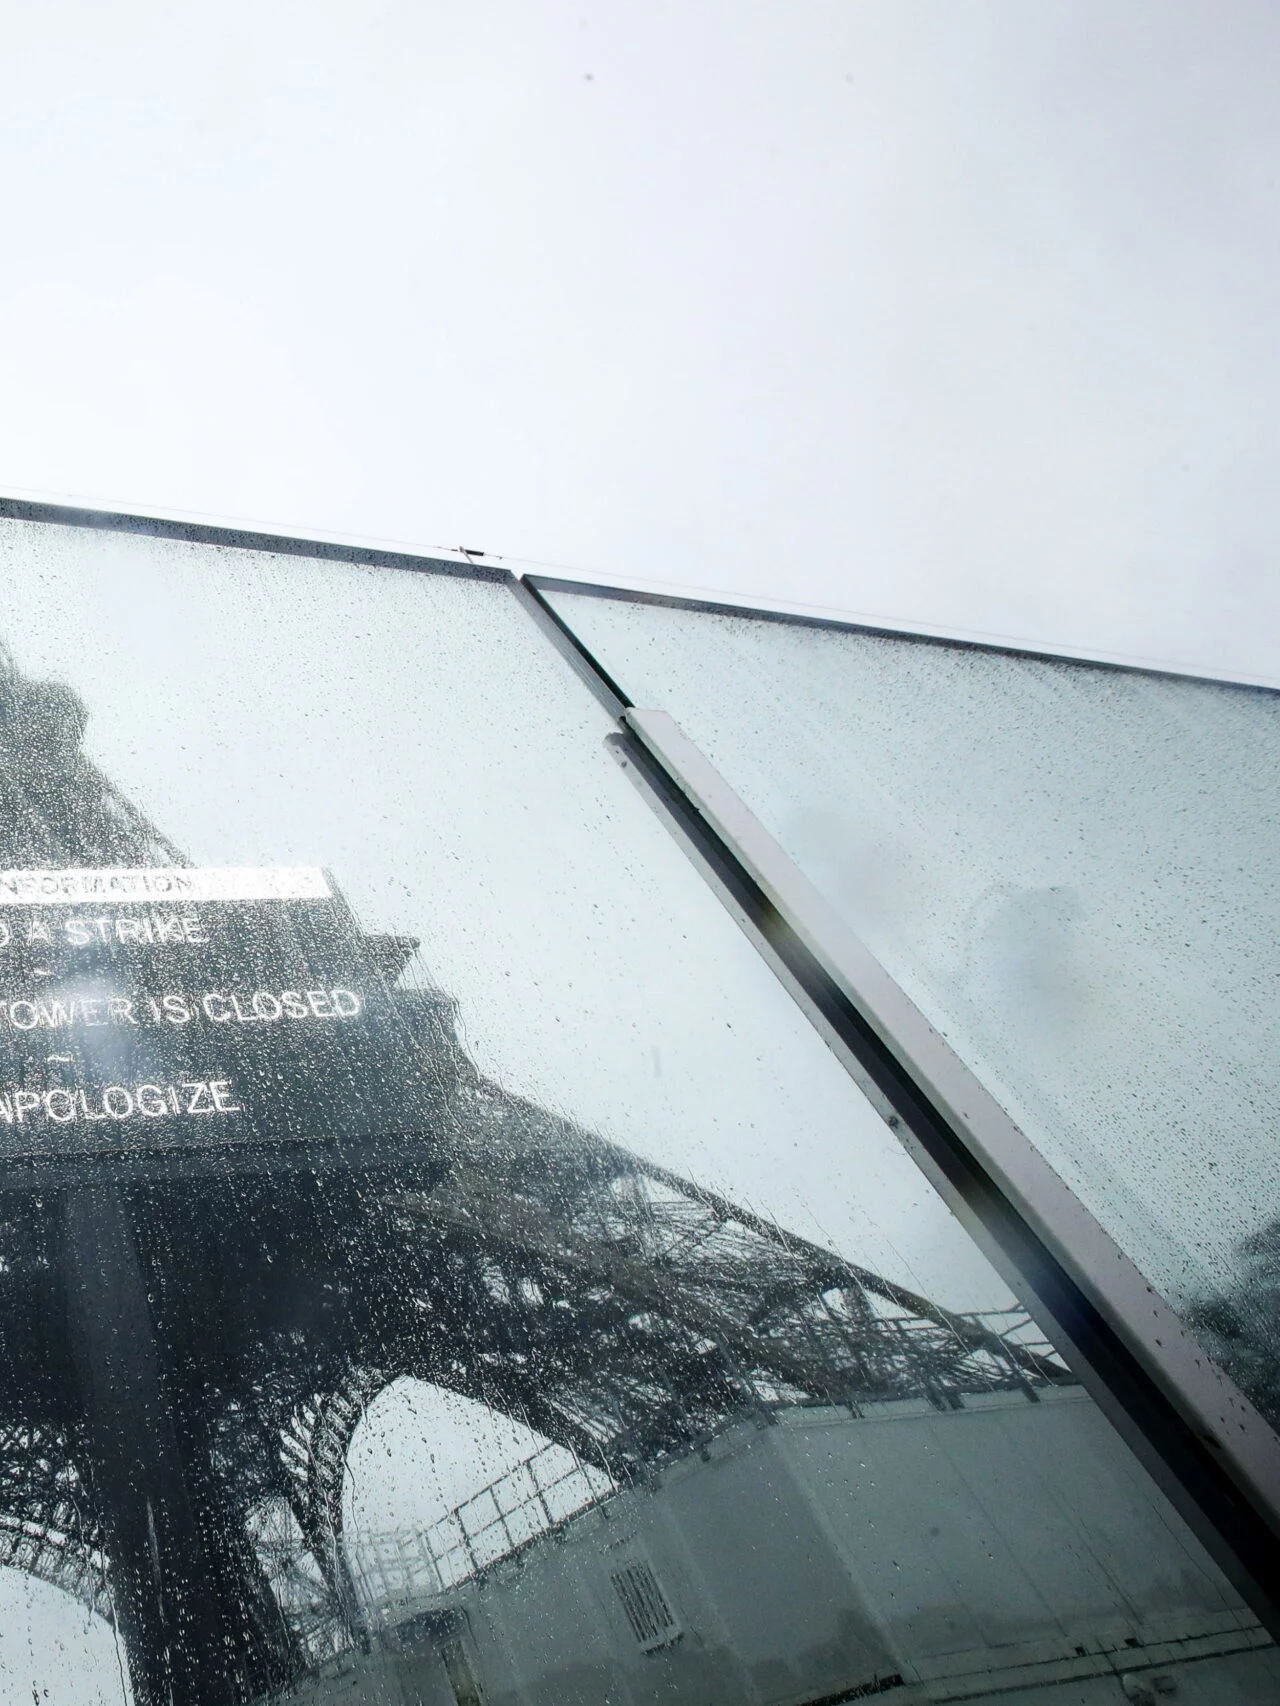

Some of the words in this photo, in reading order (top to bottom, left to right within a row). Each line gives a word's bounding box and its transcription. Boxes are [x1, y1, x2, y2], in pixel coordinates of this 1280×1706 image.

[28, 920, 50, 945] A
[65, 917, 209, 945] STRIKE
[152, 995, 191, 1023] IS
[203, 989, 360, 1022] CLOSED
